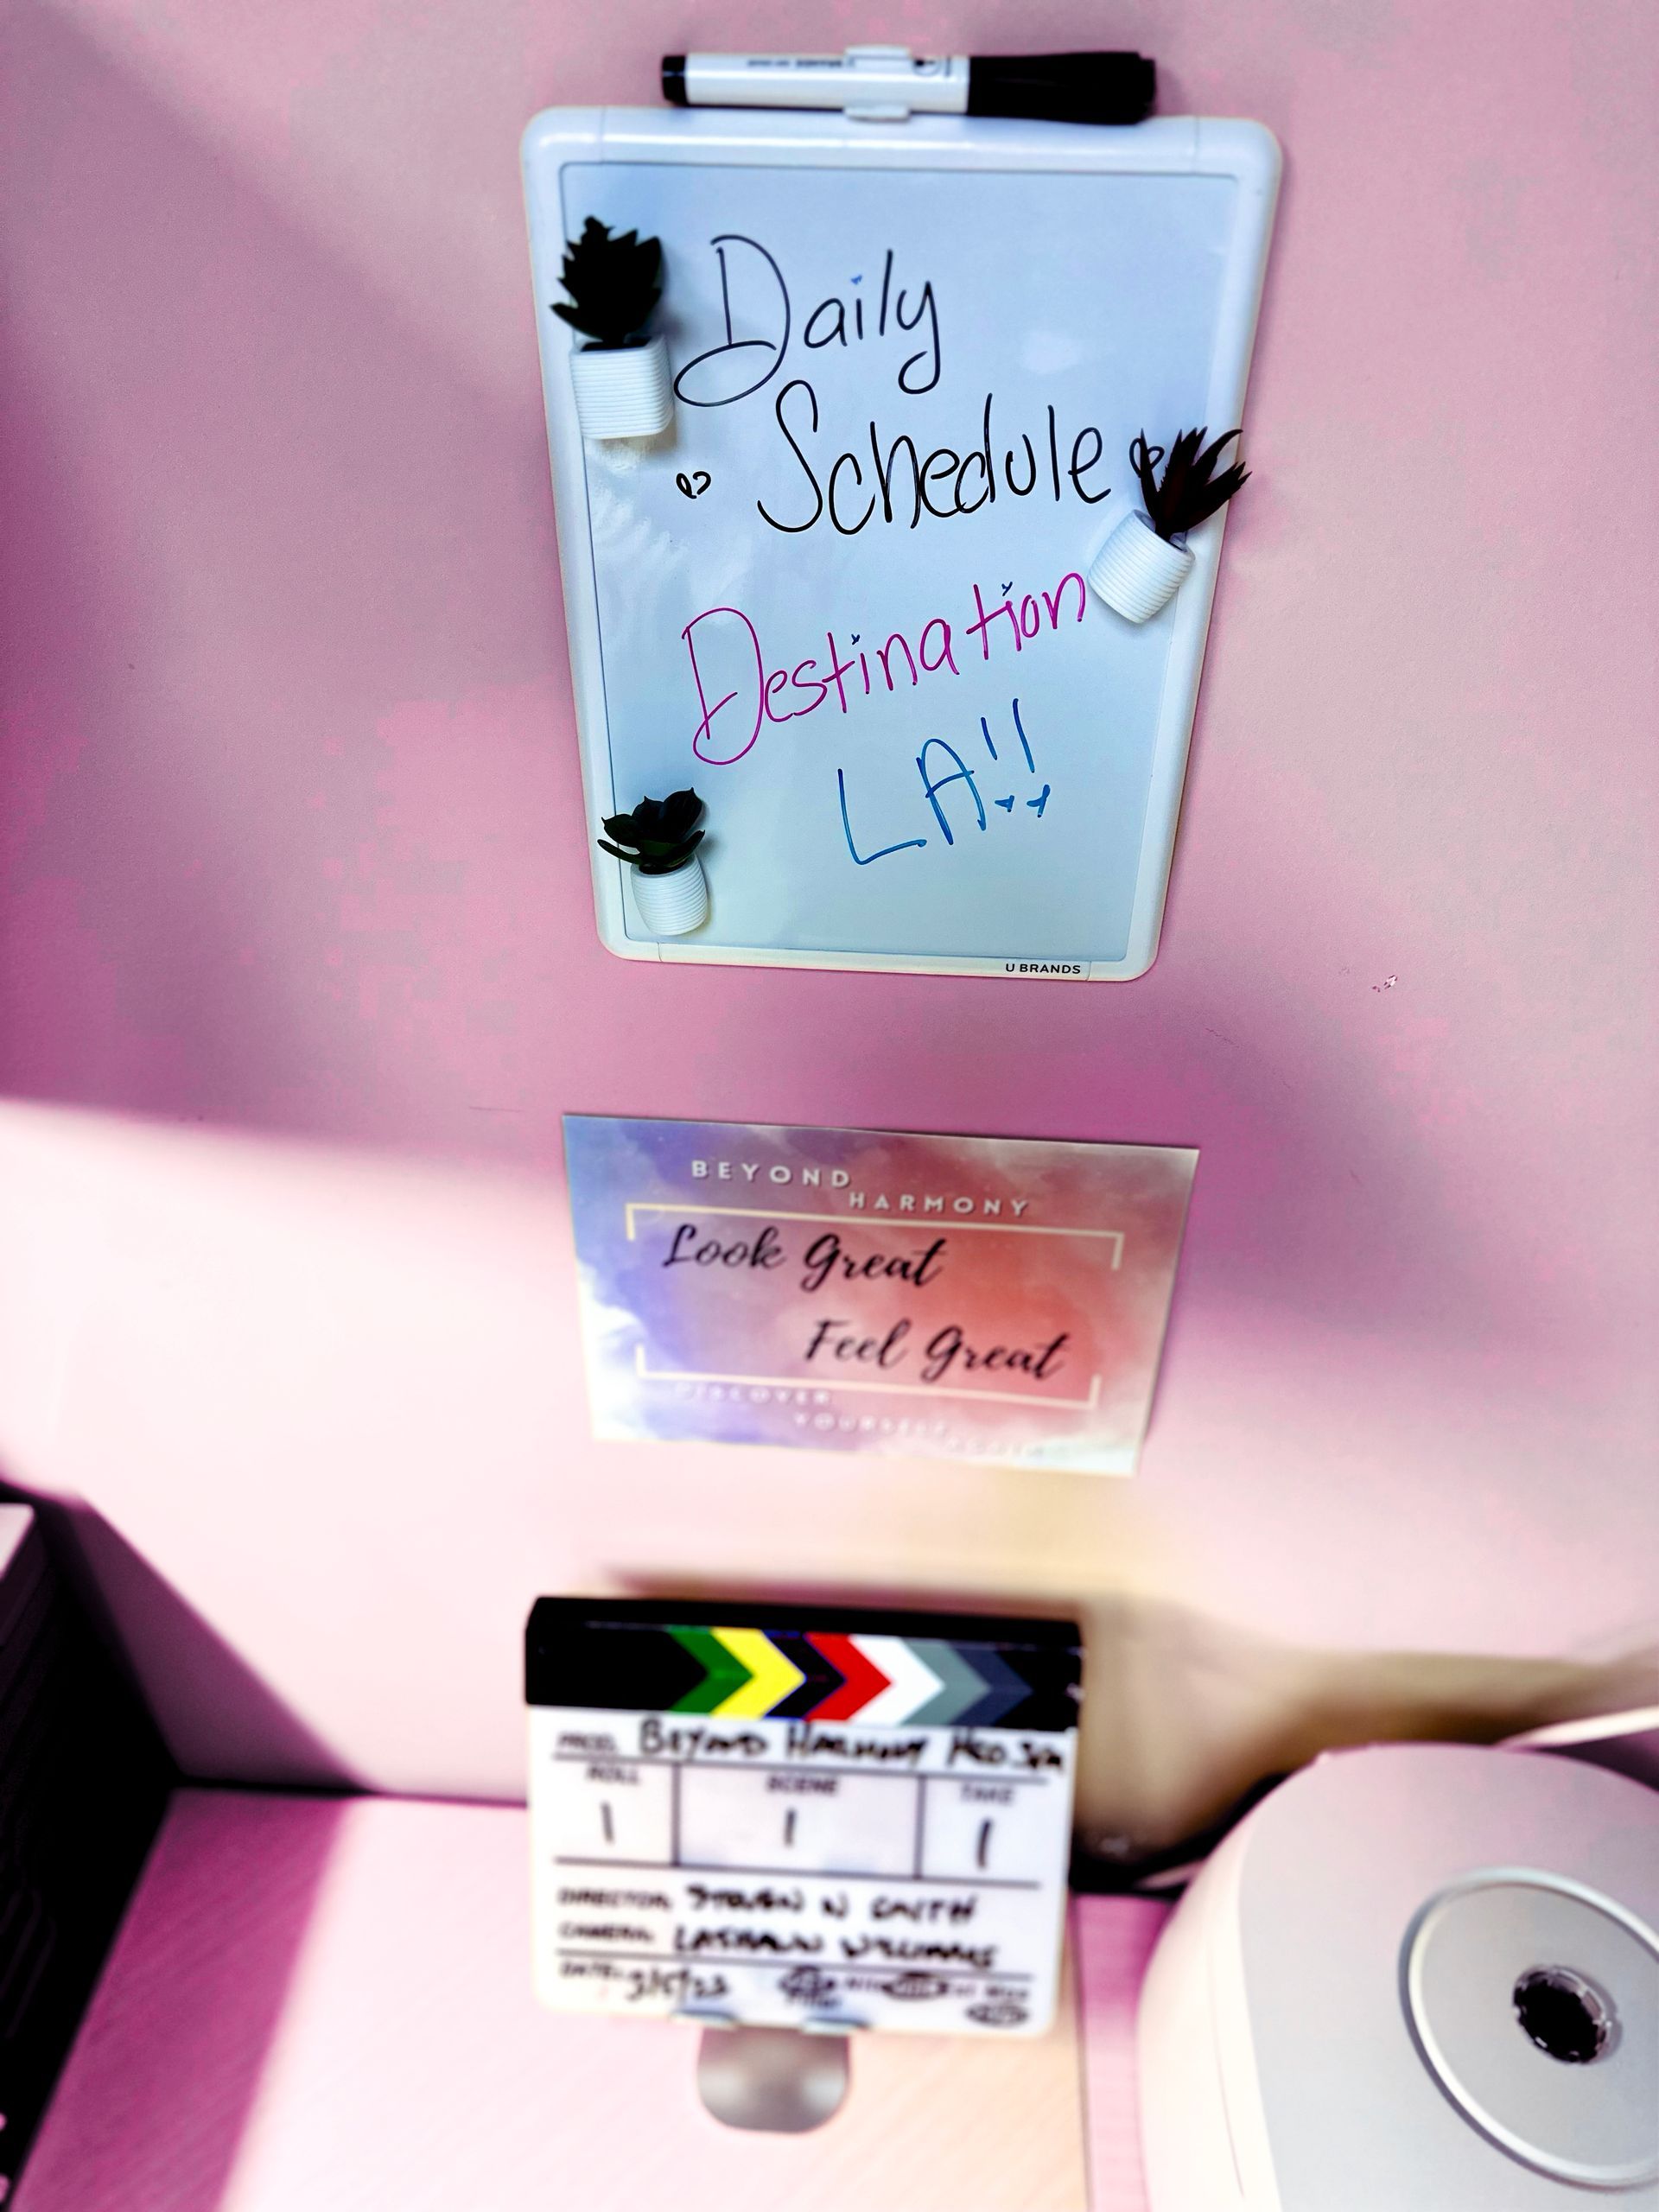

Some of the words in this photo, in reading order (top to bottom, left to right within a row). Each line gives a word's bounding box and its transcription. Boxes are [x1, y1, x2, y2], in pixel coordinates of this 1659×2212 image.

[674, 234, 941, 407] Daily
[757, 378, 1111, 535] Schedule
[682, 572, 1086, 766] Destination
[1005, 963, 1015, 972] U
[1020, 963, 1081, 974] BRANDS
[692, 1159, 851, 1188] BEYOND
[849, 1191, 1033, 1217] HARMONY
[663, 1224, 787, 1269] Look
[799, 1232, 948, 1294] Great
[802, 1318, 912, 1369] Feel
[920, 1325, 1070, 1383] Great
[675, 1382, 833, 1407] DISCOVER
[766, 1774, 840, 1796] SCENE
[960, 1783, 1016, 1807] TAKE
